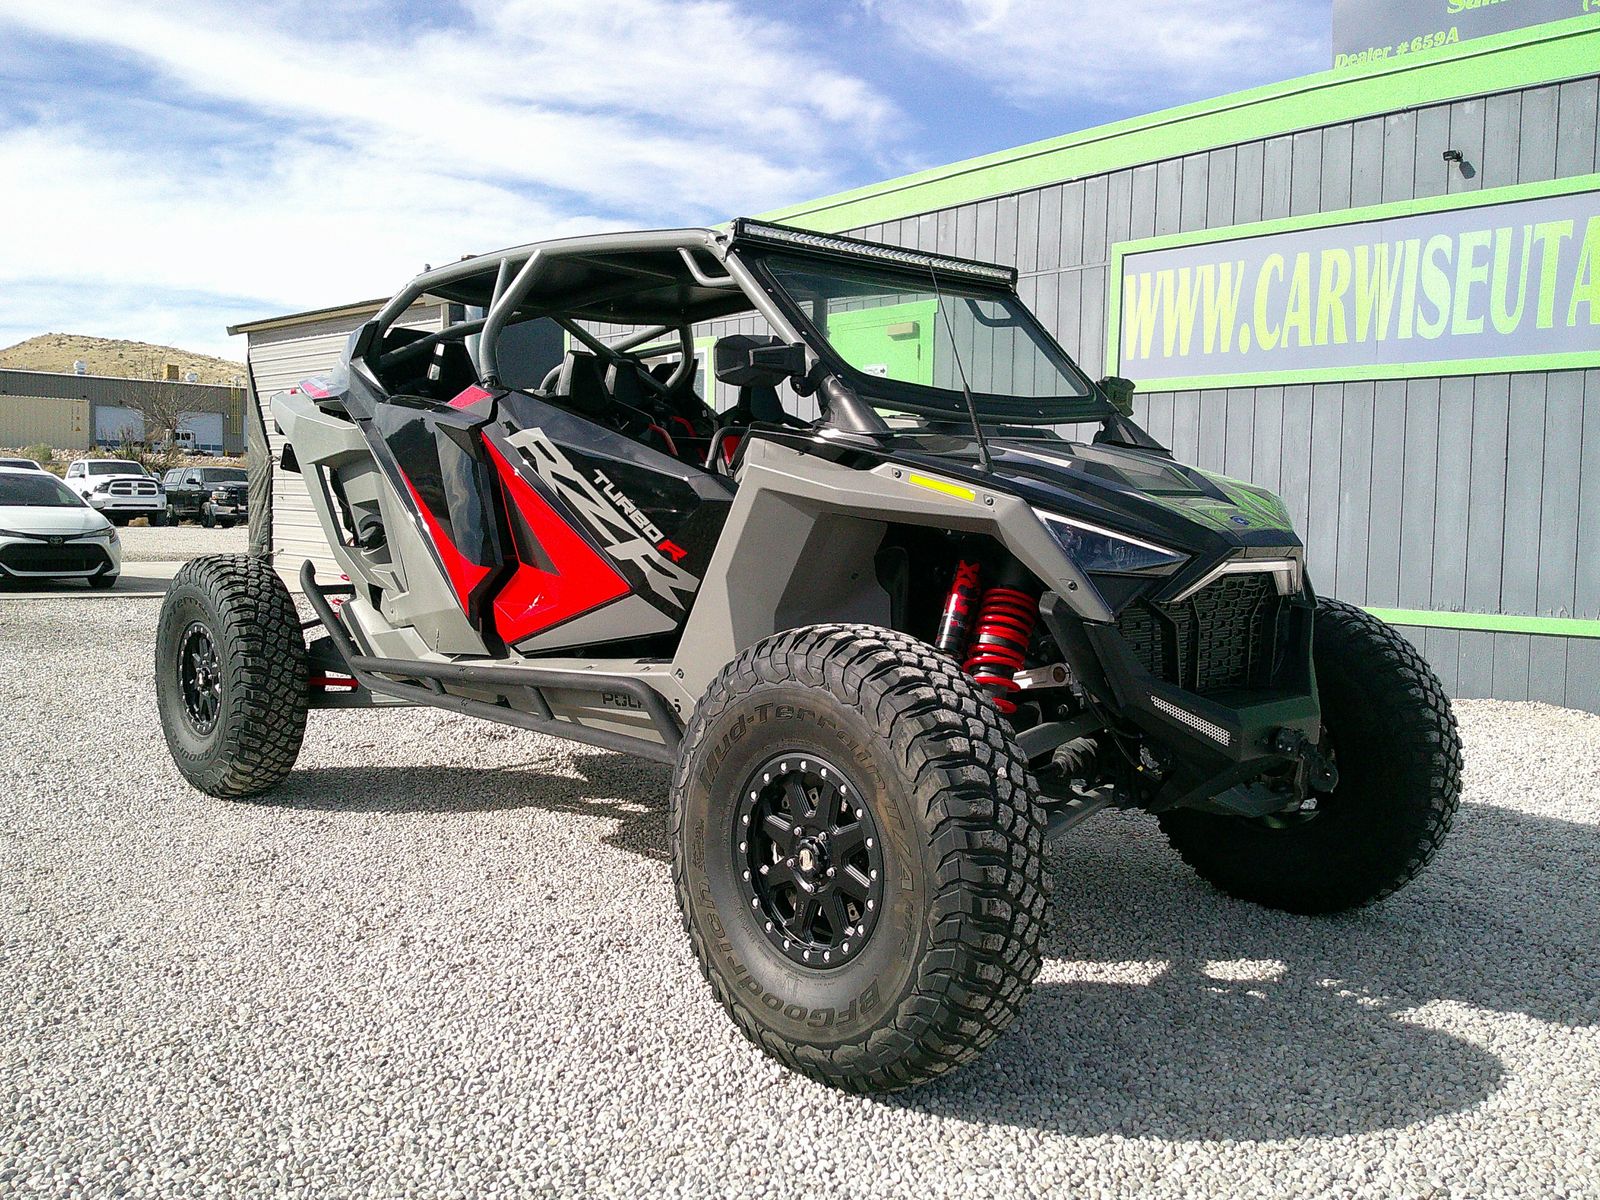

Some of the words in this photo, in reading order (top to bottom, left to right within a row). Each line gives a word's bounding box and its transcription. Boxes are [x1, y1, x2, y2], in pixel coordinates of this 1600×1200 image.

[1334, 46, 1392, 69] Dealer
[503, 427, 700, 611] RZR
[593, 468, 664, 543] TURBO
[657, 539, 688, 562] R
[700, 703, 886, 792] Mud-Terrain
[697, 874, 881, 1028] BFGoodrich
